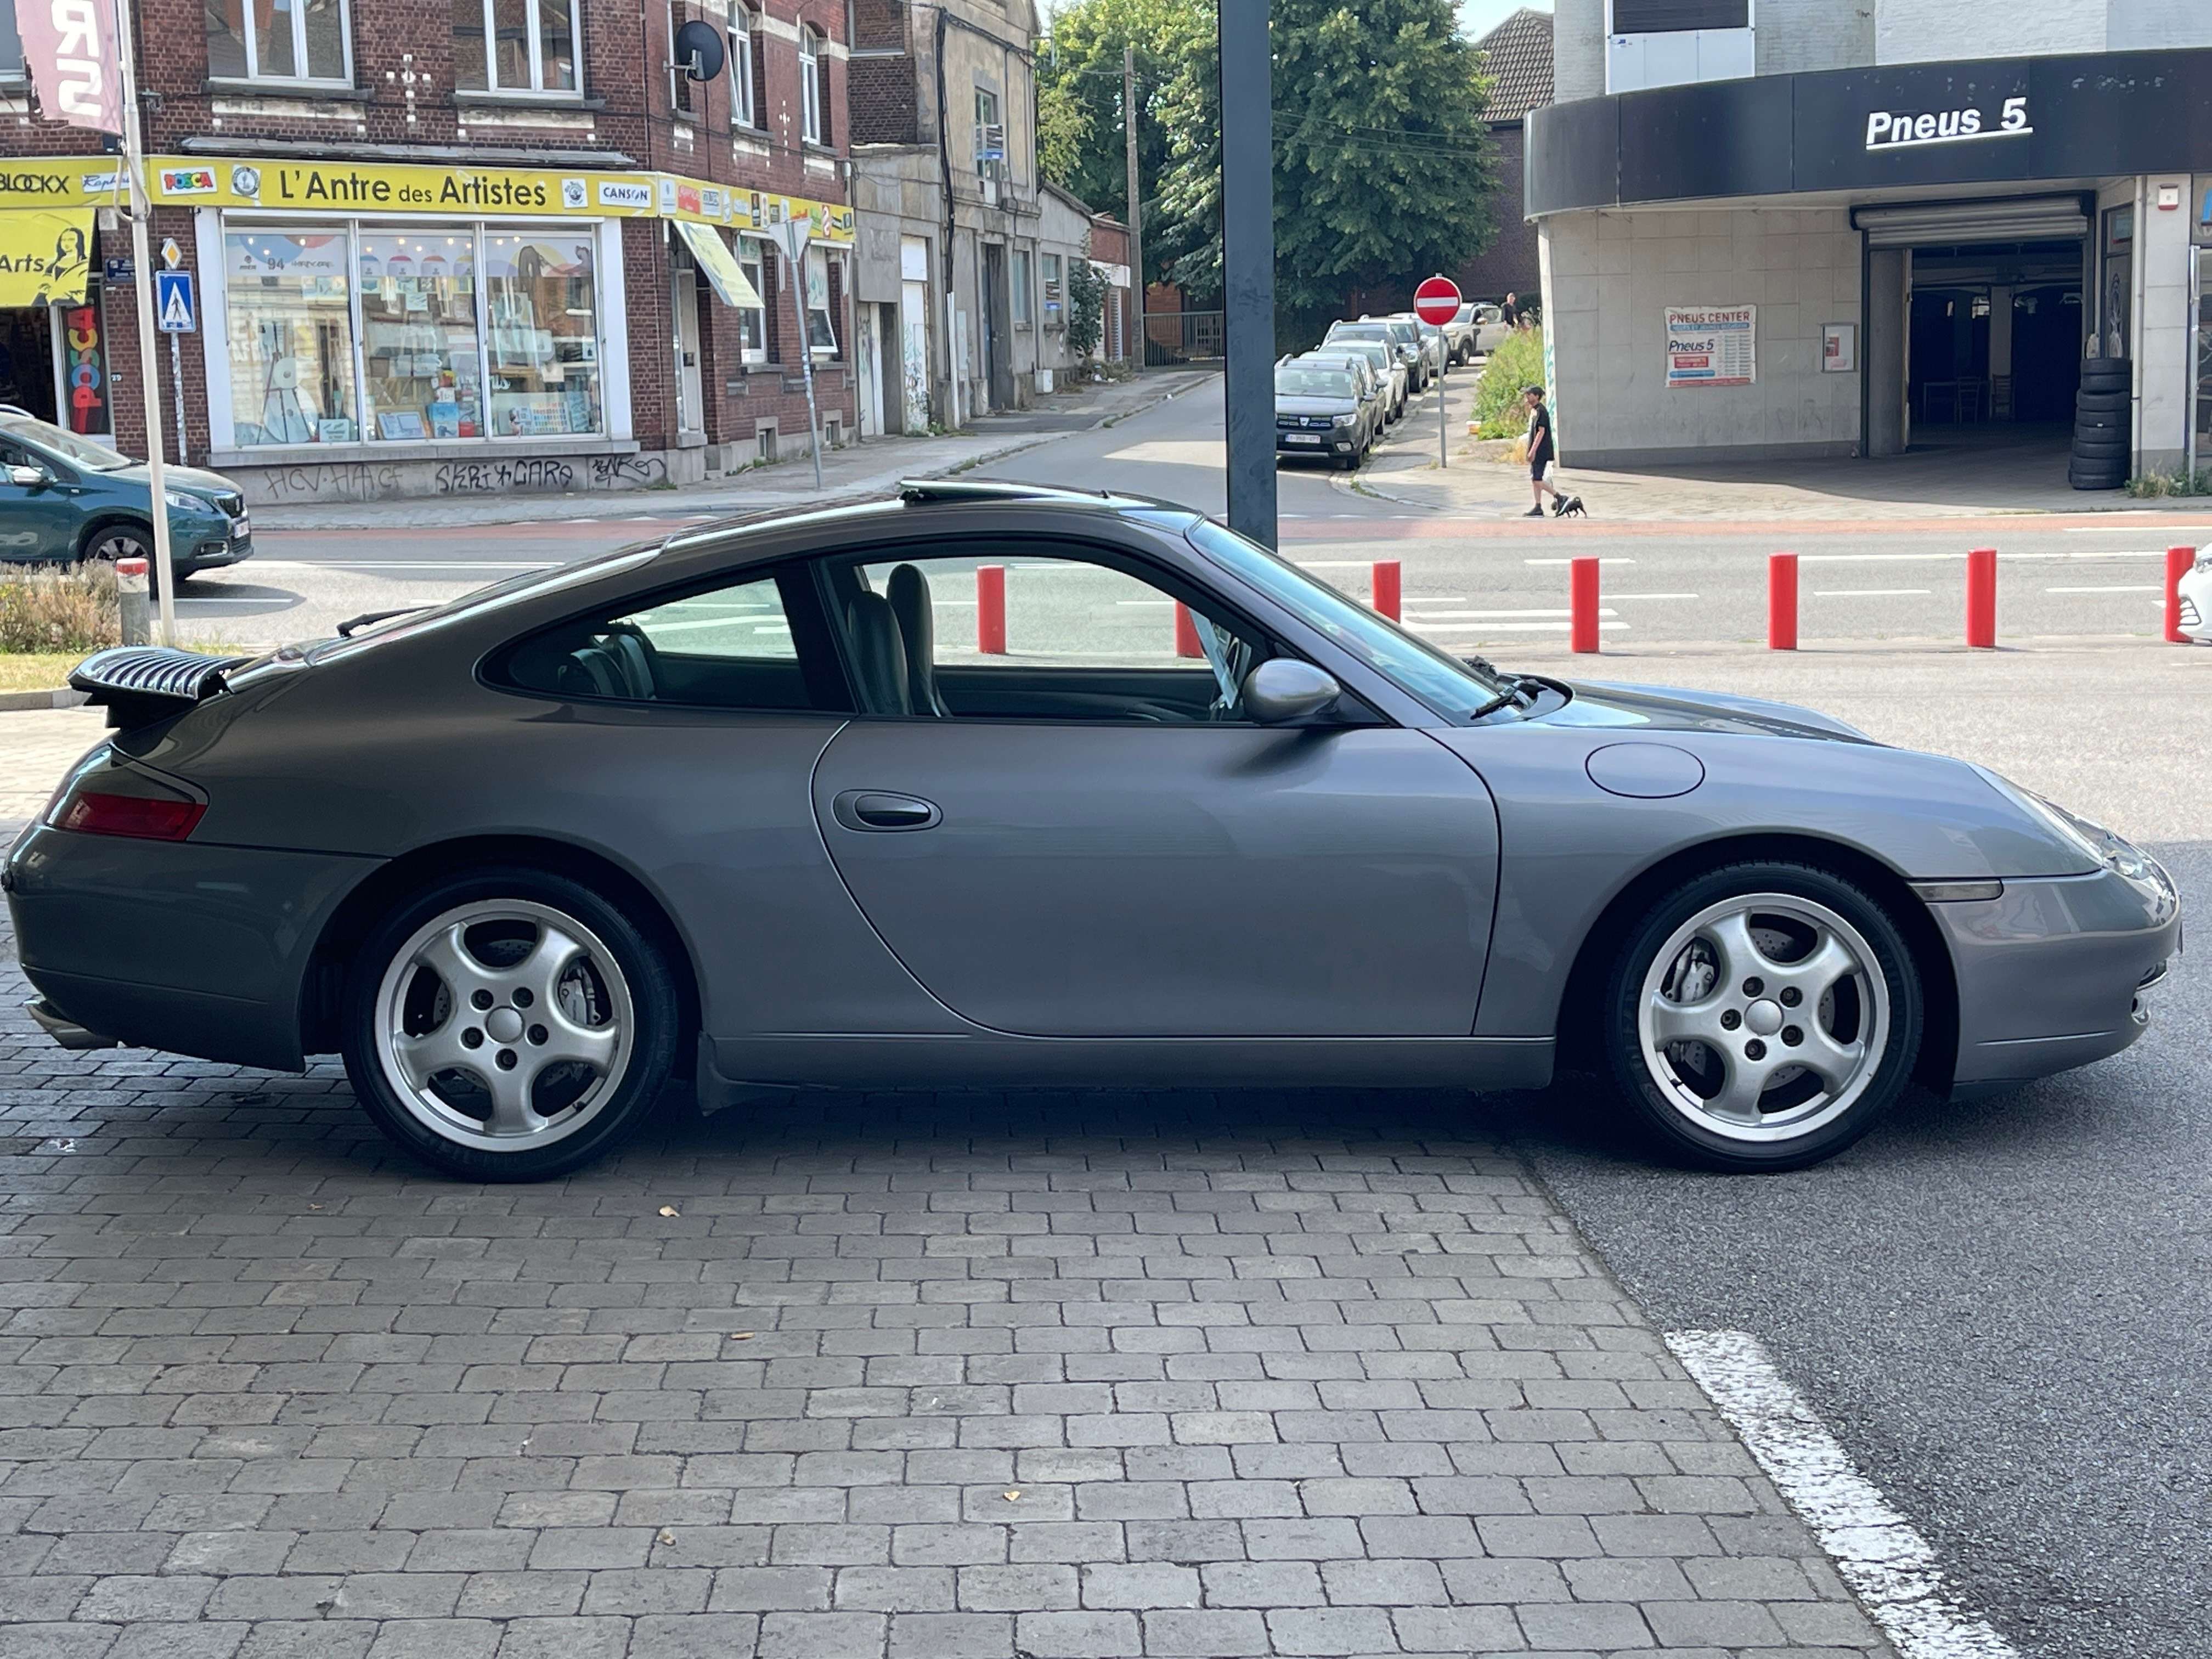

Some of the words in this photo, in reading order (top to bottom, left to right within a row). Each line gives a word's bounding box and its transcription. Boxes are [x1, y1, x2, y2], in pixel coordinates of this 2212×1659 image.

[1866, 108, 1981, 145] Pneus
[2000, 97, 2027, 131] 5
[164, 171, 213, 190] POSCA
[280, 170, 391, 201] L'Antre
[399, 184, 432, 202] des
[439, 176, 546, 206] Artistes
[603, 187, 648, 201] CANSON
[0, 253, 44, 273] Arts
[267, 258, 285, 270] 94
[1669, 313, 1705, 324] PNEUS
[1708, 311, 1750, 323] CENTER
[1668, 340, 1705, 352] Pneus
[1706, 338, 1715, 351] 5
[67, 307, 102, 408] POSCA
